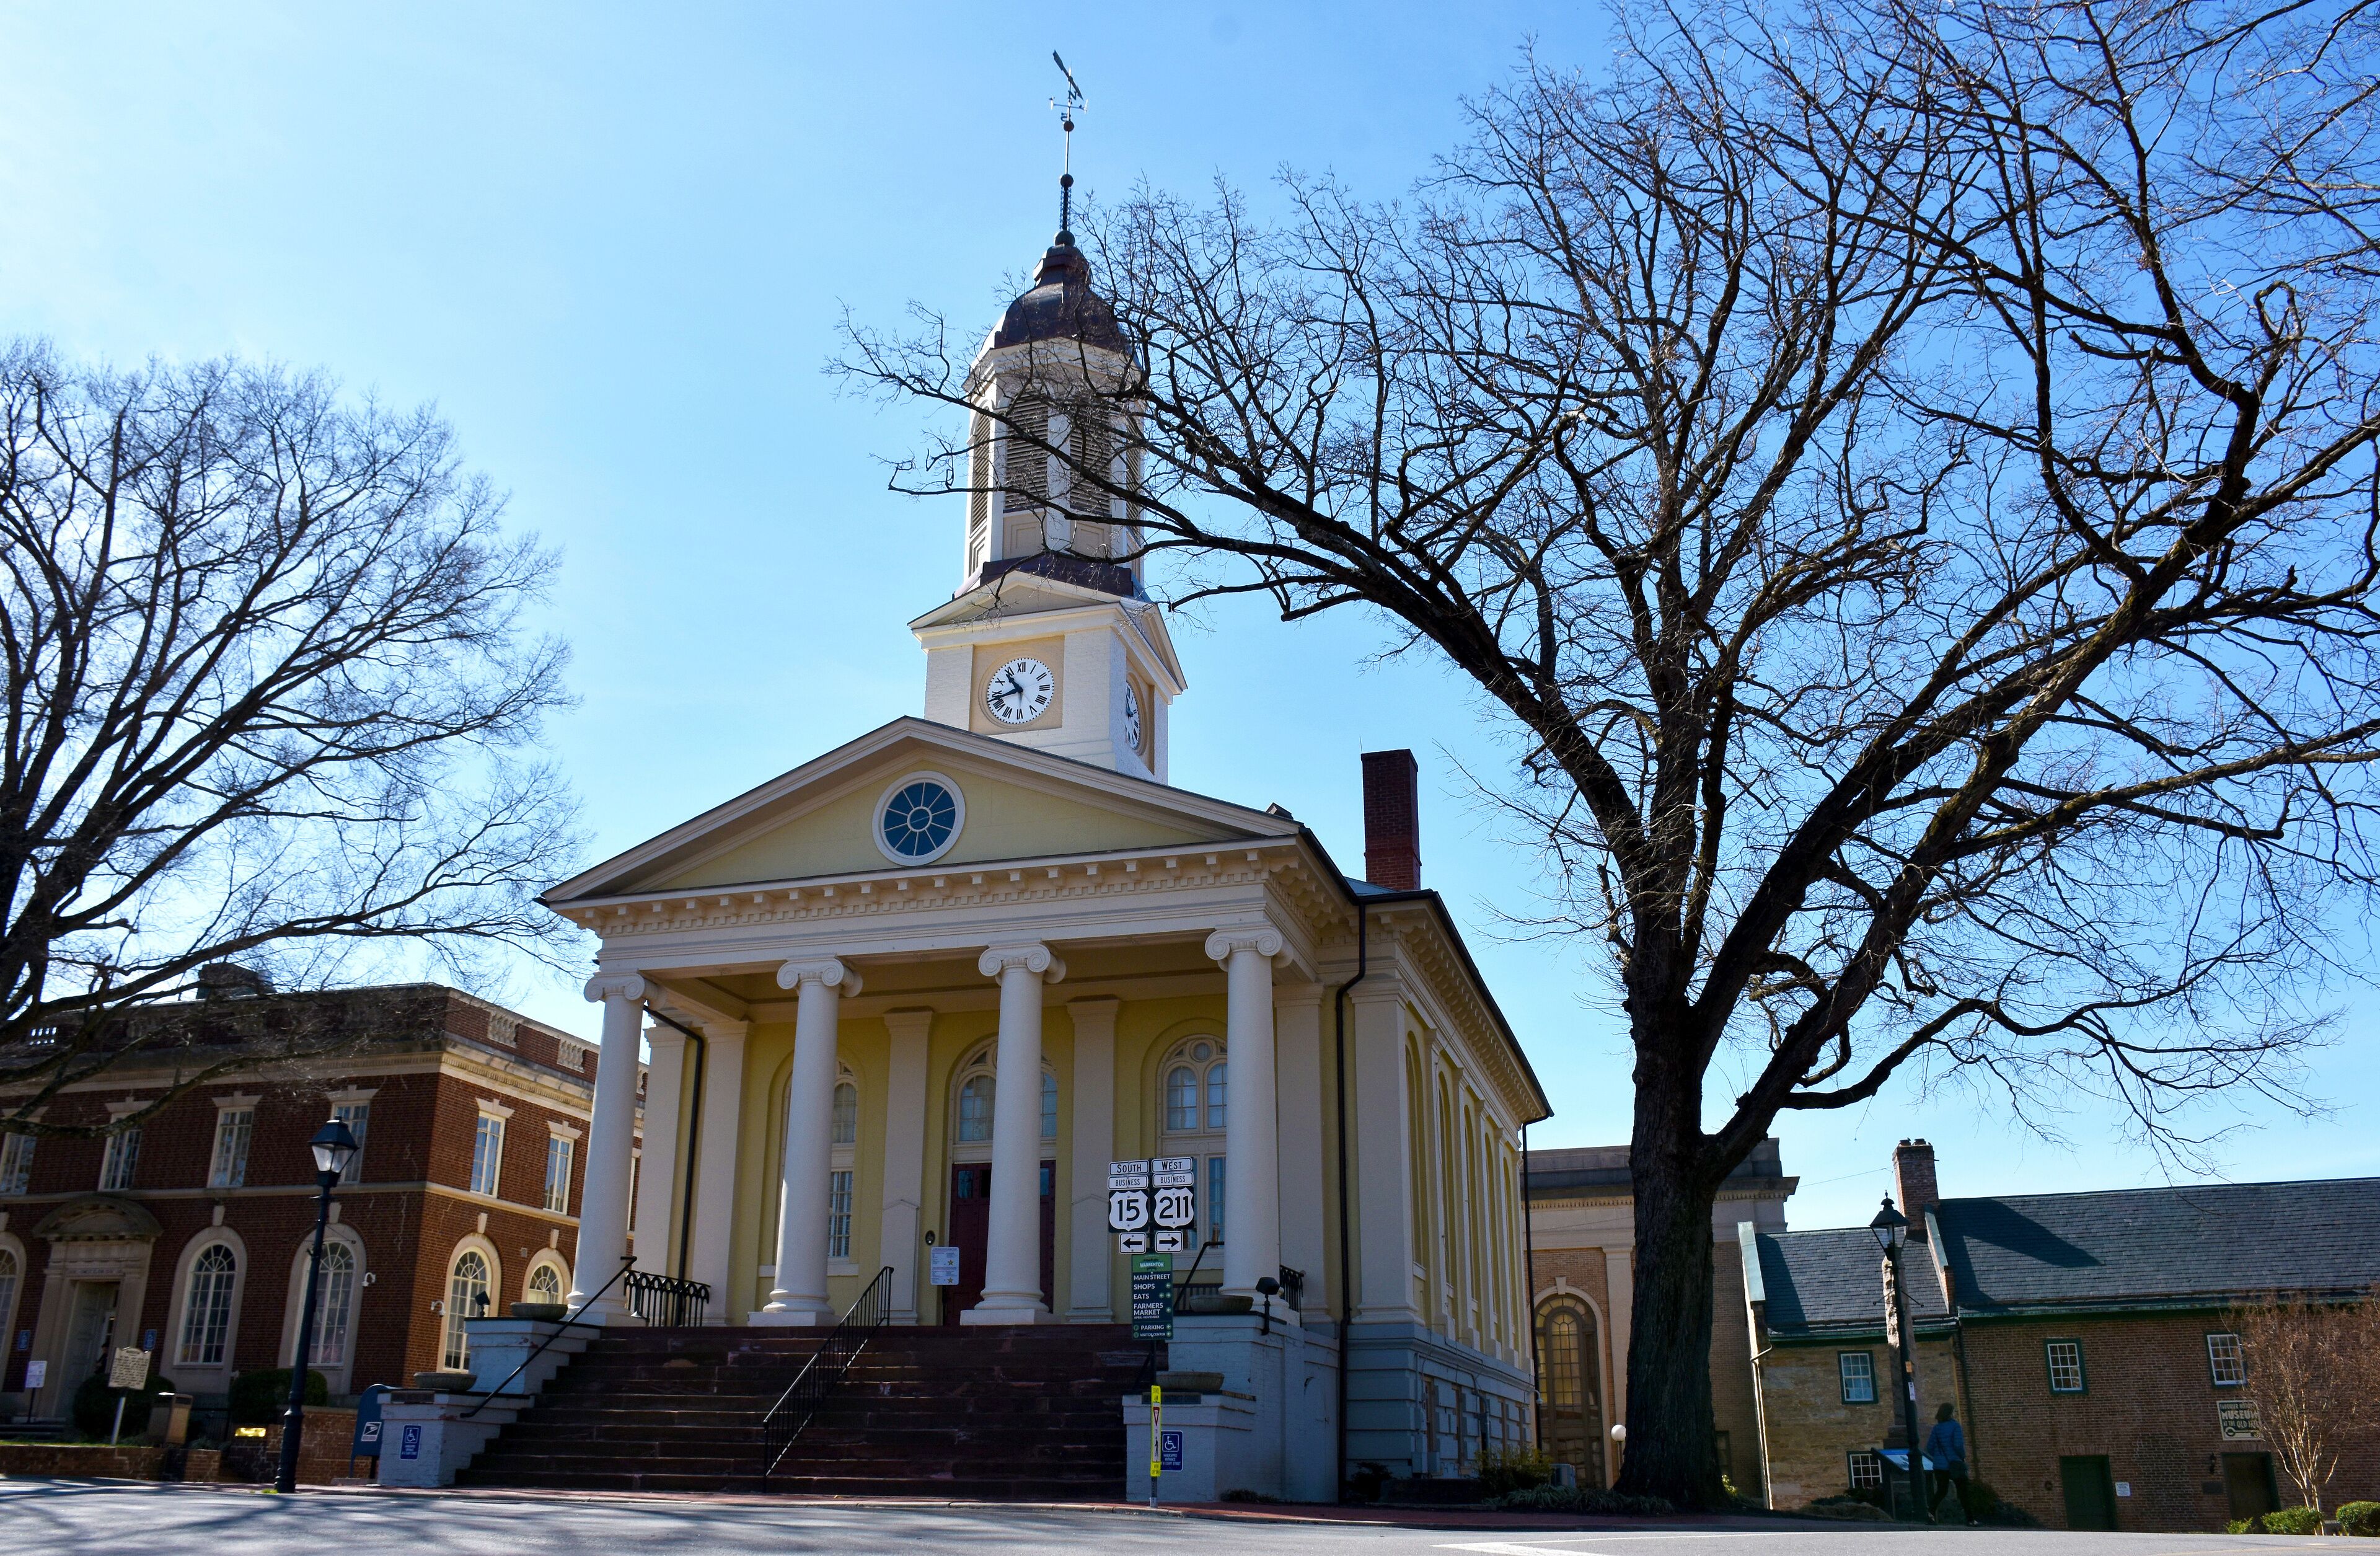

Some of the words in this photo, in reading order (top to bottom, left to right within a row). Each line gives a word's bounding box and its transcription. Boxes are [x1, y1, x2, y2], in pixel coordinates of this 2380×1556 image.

[1017, 661, 1026, 673] XII
[1036, 671, 1047, 681] II
[994, 677, 1006, 686] X
[1039, 684, 1051, 692] III
[1034, 694, 1047, 705] IIII
[1002, 706, 1013, 719] VII
[1016, 708, 1023, 720] VI
[1029, 705, 1038, 715] V
[1117, 1164, 1142, 1174] SOUTH
[1161, 1161, 1183, 1170] WEST
[1117, 1198, 1140, 1222] 15
[1160, 1196, 1189, 1219] 211
[2221, 1410, 2260, 1420] MUSEUM
